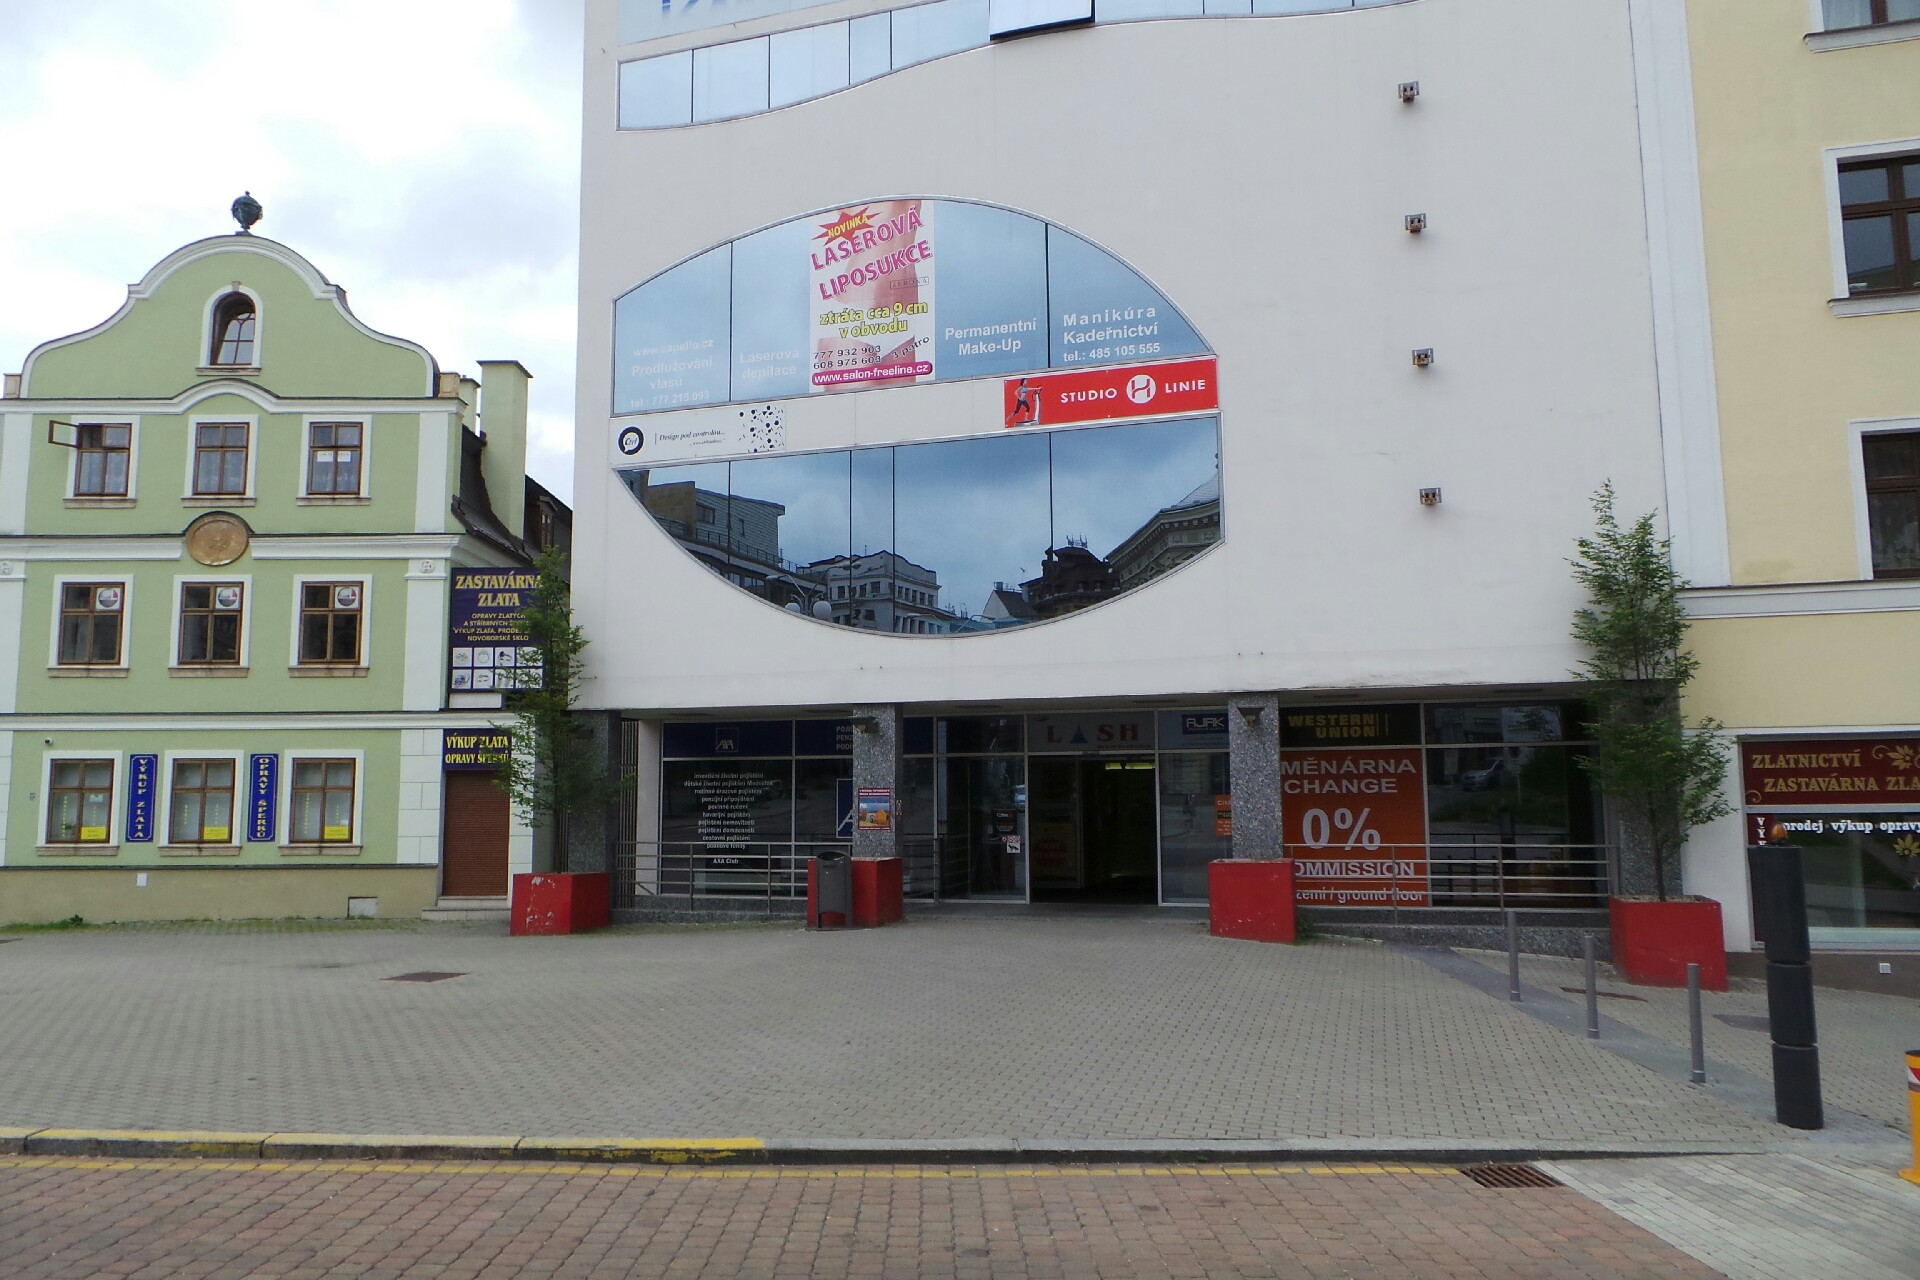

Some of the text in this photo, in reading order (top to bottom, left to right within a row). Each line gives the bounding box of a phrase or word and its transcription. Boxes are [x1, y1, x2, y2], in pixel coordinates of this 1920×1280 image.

[828, 213, 868, 238] NOVINKA
[811, 206, 925, 271] LASEROVÁ
[819, 240, 933, 300] LIPOSUKCE
[820, 302, 928, 326] ztráta cca 9 cm
[1063, 307, 1156, 327] Manikúra
[840, 318, 908, 338] v obvodu
[945, 318, 1037, 340] Permanentní
[1063, 322, 1158, 344] Kadeřnictví
[814, 345, 881, 360] 777 932 903
[902, 337, 930, 356] patro
[958, 338, 1022, 356] Make-Up
[1063, 342, 1160, 362] tel.: 485 105 555
[814, 356, 881, 370] 608 975 603
[743, 365, 798, 382] depilace
[814, 365, 929, 383] www.salon-freeline.cz
[652, 395, 669, 406] 777
[1060, 388, 1117, 403] STUDIO
[1165, 379, 1206, 394] LINIE
[478, 593, 520, 607] ZLATA
[1287, 713, 1376, 727] WESTERN
[446, 732, 509, 749] VÝKUP ZLATA
[1315, 725, 1376, 739] UNION
[716, 740, 734, 751] AXA
[445, 753, 476, 764] OPRAVY
[1280, 756, 1417, 775] MĚNÁRNA
[1752, 749, 1862, 769] ZLATNICTVÍ
[258, 758, 270, 795] OPRAVY
[1764, 773, 1879, 792] ZASTAVÁRNA
[1283, 778, 1398, 795] CHANGE
[134, 758, 148, 838] VÝKUP ZLATA
[1302, 807, 1381, 851] 0%
[1830, 820, 1873, 834] výkup
[1338, 887, 1387, 903] ground
